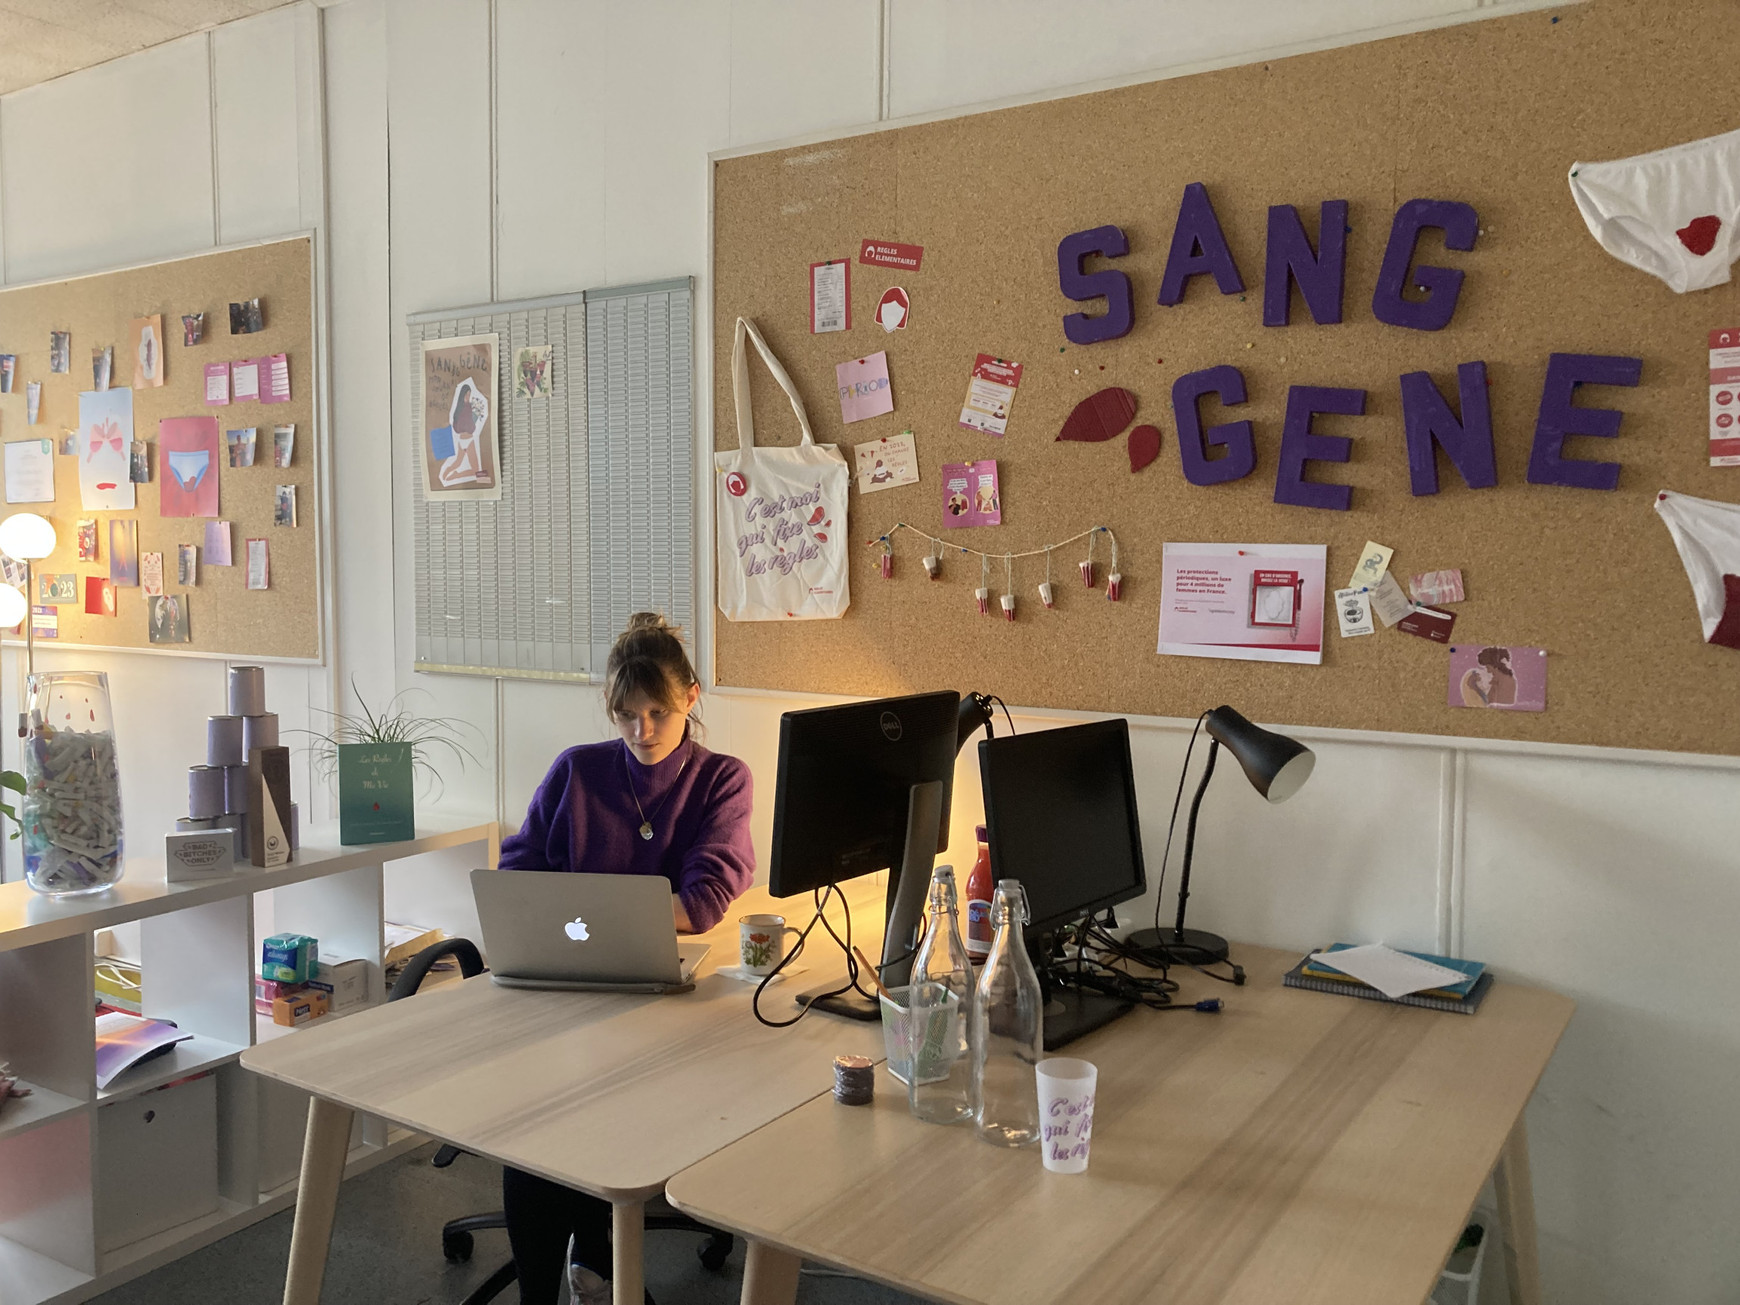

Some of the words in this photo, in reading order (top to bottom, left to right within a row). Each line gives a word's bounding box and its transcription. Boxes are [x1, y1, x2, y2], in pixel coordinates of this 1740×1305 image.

[875, 255, 917, 266] ELEMENTAIRES
[1057, 182, 1480, 345] SANG
[1171, 353, 1644, 511] GENE
[786, 482, 821, 512] moi
[737, 524, 766, 558] qui
[771, 517, 804, 547] fixe
[745, 553, 767, 577] les
[183, 849, 217, 858] BITCHES
[1044, 1119, 1070, 1142] qui
